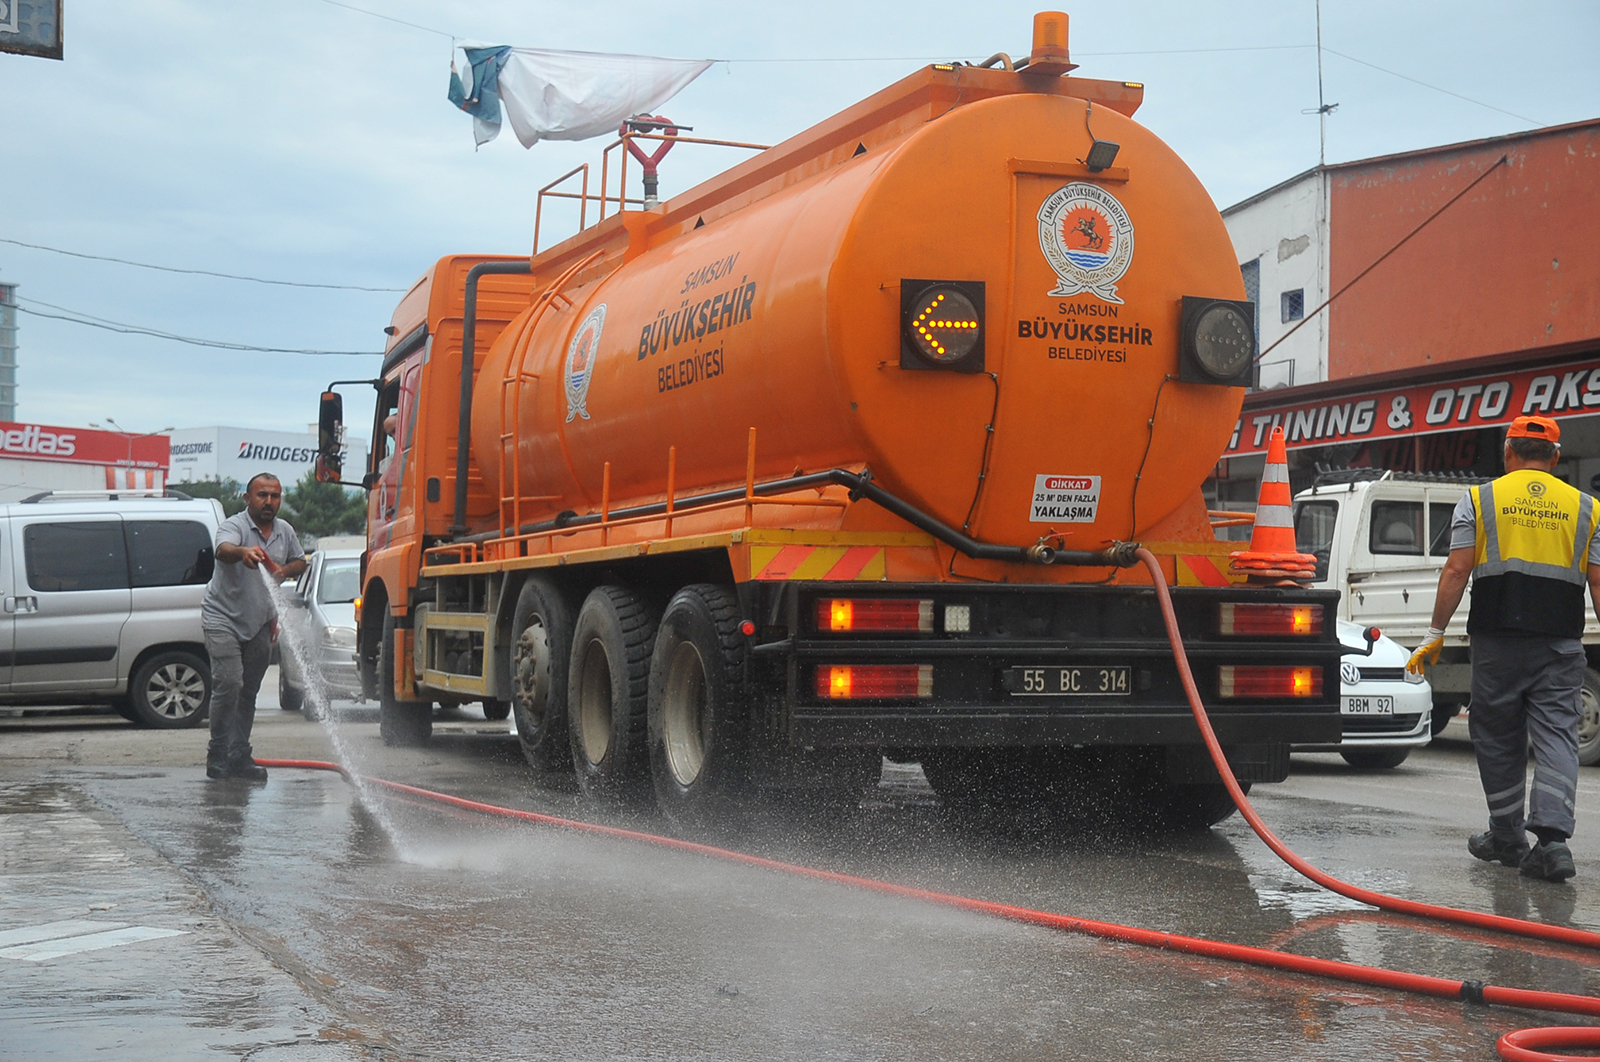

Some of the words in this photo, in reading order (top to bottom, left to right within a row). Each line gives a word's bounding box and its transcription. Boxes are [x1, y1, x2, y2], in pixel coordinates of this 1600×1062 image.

[1044, 194, 1065, 220] SAMSUN
[680, 251, 740, 294] SAMSUN
[637, 274, 756, 361] BÜYÜKŞEHİR
[1058, 302, 1118, 318] SAMSUN
[1018, 316, 1153, 346] BÜYÜKŞEHİR
[1048, 346, 1127, 363] BELEDİYESİ
[657, 340, 724, 393] BELEDİYESİ
[1252, 399, 1377, 446] TUNING
[1386, 395, 1413, 430] &
[1425, 381, 1510, 424] OTO
[1051, 479, 1087, 489] DİKKAT
[1035, 493, 1045, 502] 25
[1056, 494, 1073, 503] DEN
[1074, 494, 1096, 503] FAZLA
[1514, 497, 1558, 509] SAMSUN
[1034, 506, 1093, 520] YAKLAŞMA
[1502, 505, 1569, 521] BÜYÜKŞEHİR
[1512, 517, 1559, 531] BELEDİYESİ
[1024, 669, 1045, 691] 55
[1060, 669, 1081, 691] BC
[1099, 669, 1127, 691] 314
[1349, 698, 1369, 713] BBM
[1377, 698, 1390, 713] 92
